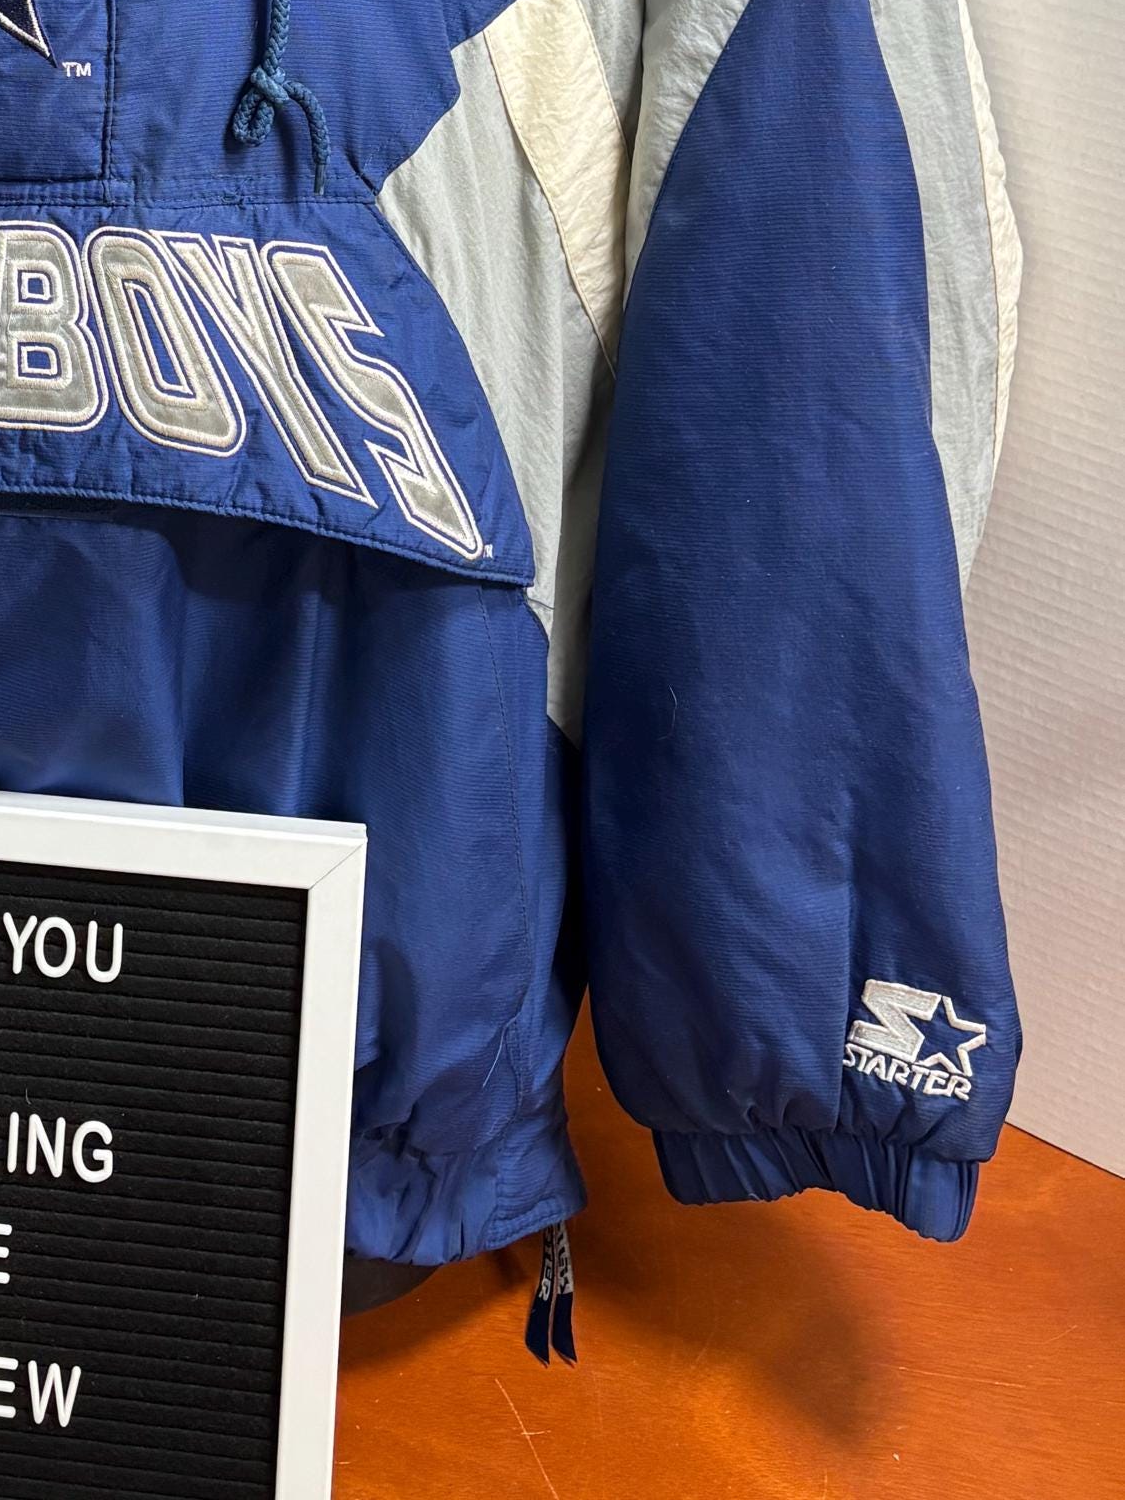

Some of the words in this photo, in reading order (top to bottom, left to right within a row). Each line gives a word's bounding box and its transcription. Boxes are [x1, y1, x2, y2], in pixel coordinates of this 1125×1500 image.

[62, 61, 92, 78] TM
[2, 911, 124, 983] YOU
[842, 1043, 972, 1101] STARTER
